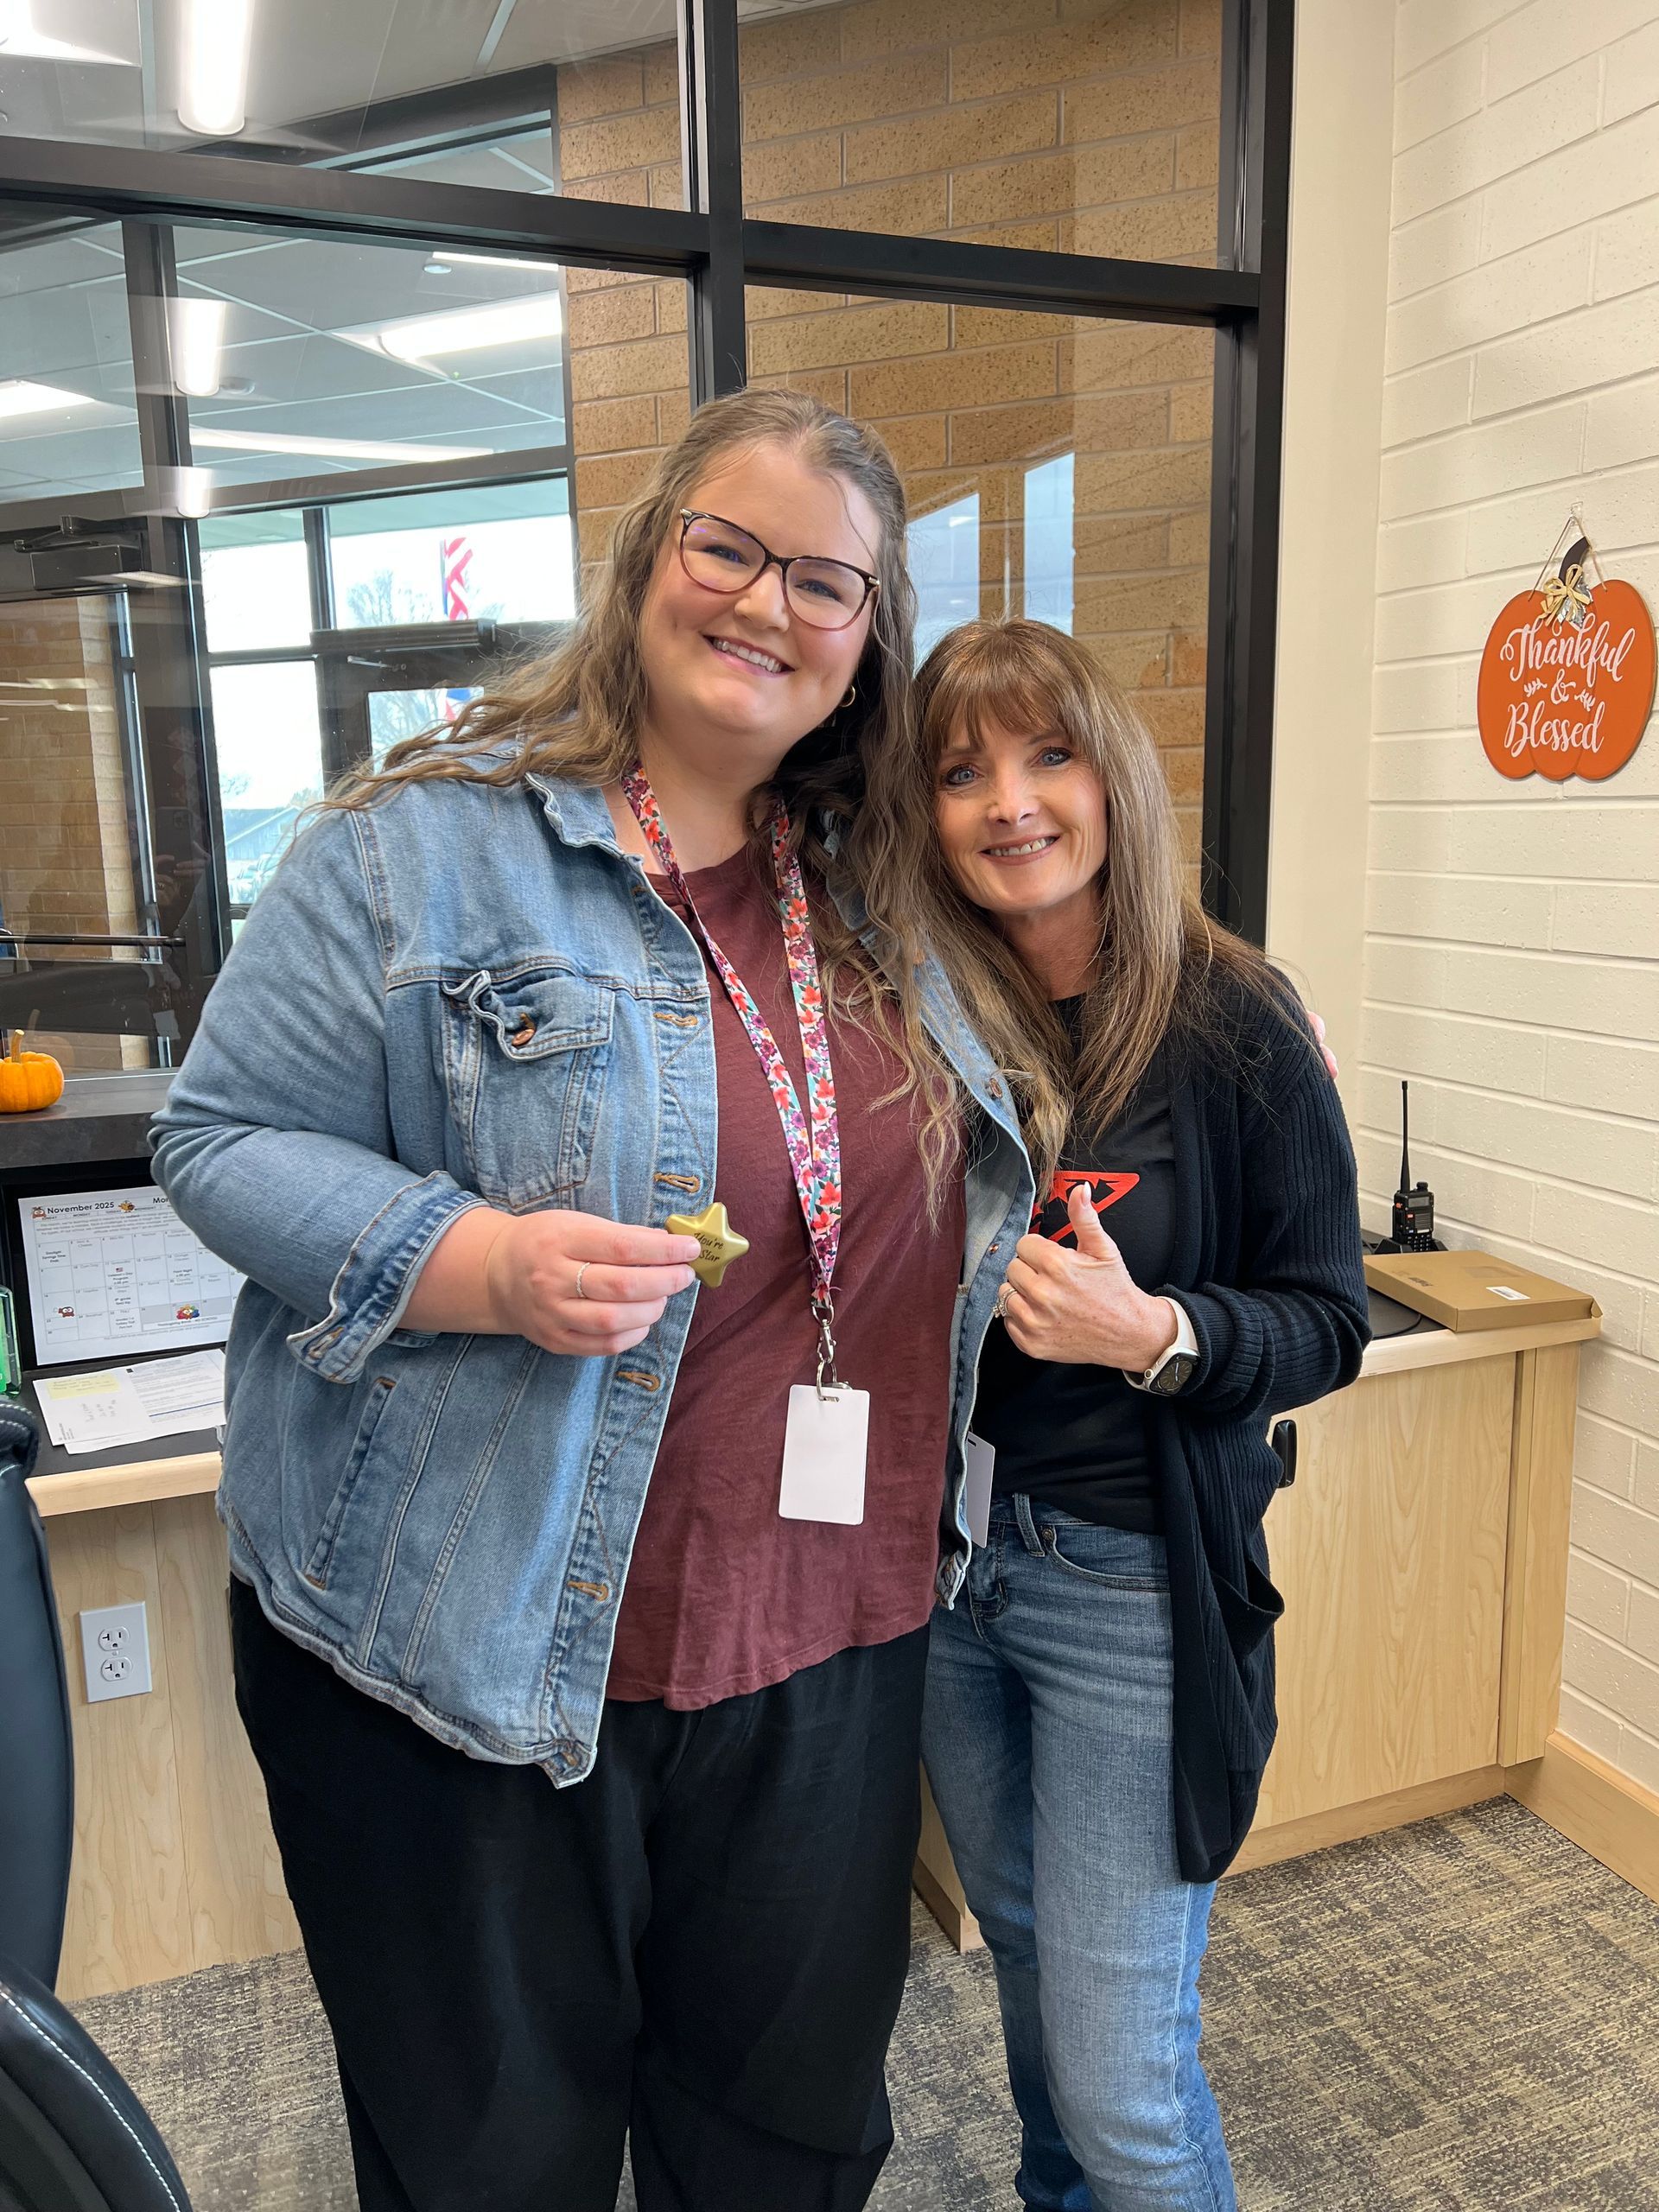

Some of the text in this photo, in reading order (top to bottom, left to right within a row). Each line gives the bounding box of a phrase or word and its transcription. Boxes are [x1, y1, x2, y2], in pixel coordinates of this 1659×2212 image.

[1500, 613, 1635, 688] Thankful
[1550, 668, 1576, 705] &
[1504, 701, 1605, 758] Blessed
[47, 1201, 115, 1214] November 2025
[694, 1232, 724, 1249] You're
[699, 1249, 720, 1262] Star
